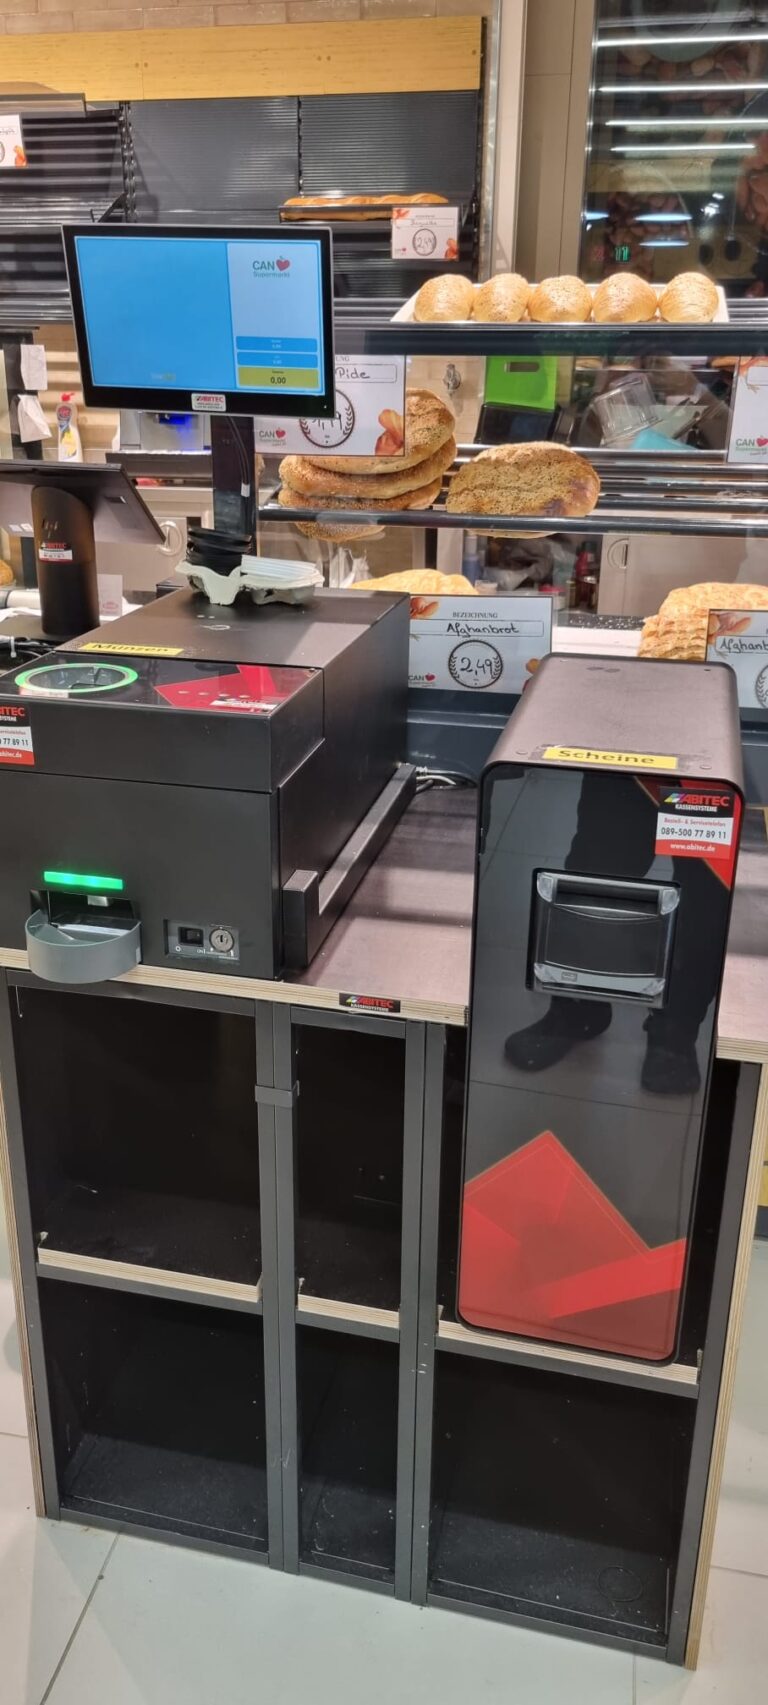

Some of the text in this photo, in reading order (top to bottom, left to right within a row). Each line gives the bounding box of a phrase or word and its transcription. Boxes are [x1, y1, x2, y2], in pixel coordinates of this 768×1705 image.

[252, 260, 275, 271] CAN
[258, 430, 275, 438] CAN
[735, 438, 755, 447] CAN
[446, 622, 520, 638] Afghanbrot
[460, 657, 494, 679] 2,49
[558, 749, 656, 764] Scheine
[679, 794, 729, 806] ABITEC
[675, 804, 717, 812] KASSENSYSTEME
[661, 828, 692, 836] 089-500
[695, 830, 704, 838] 77
[670, 843, 716, 852] www.abitec.de
